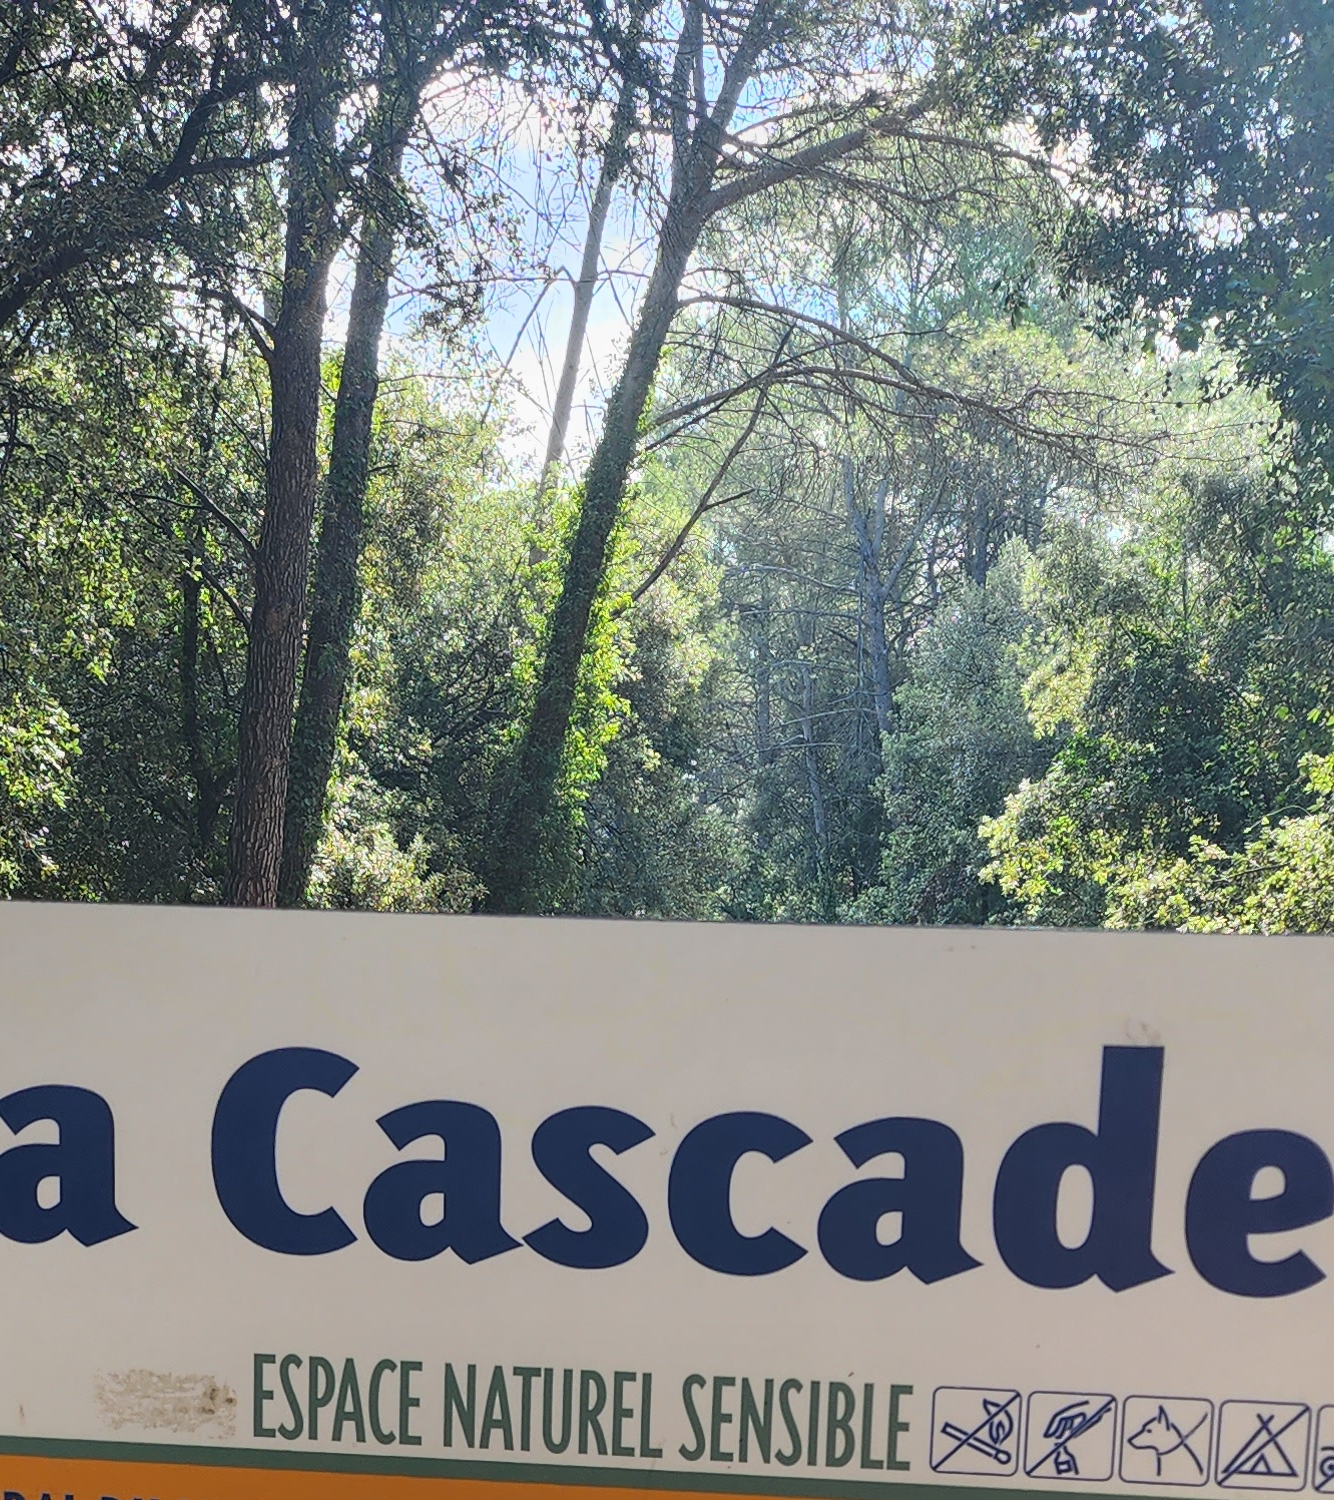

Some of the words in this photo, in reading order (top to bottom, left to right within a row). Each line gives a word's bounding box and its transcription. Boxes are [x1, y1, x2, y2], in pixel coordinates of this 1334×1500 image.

[253, 1352, 423, 1446] ESPACE
[443, 1361, 663, 1459] NATUREL
[678, 1373, 913, 1471] SENSIBLE
